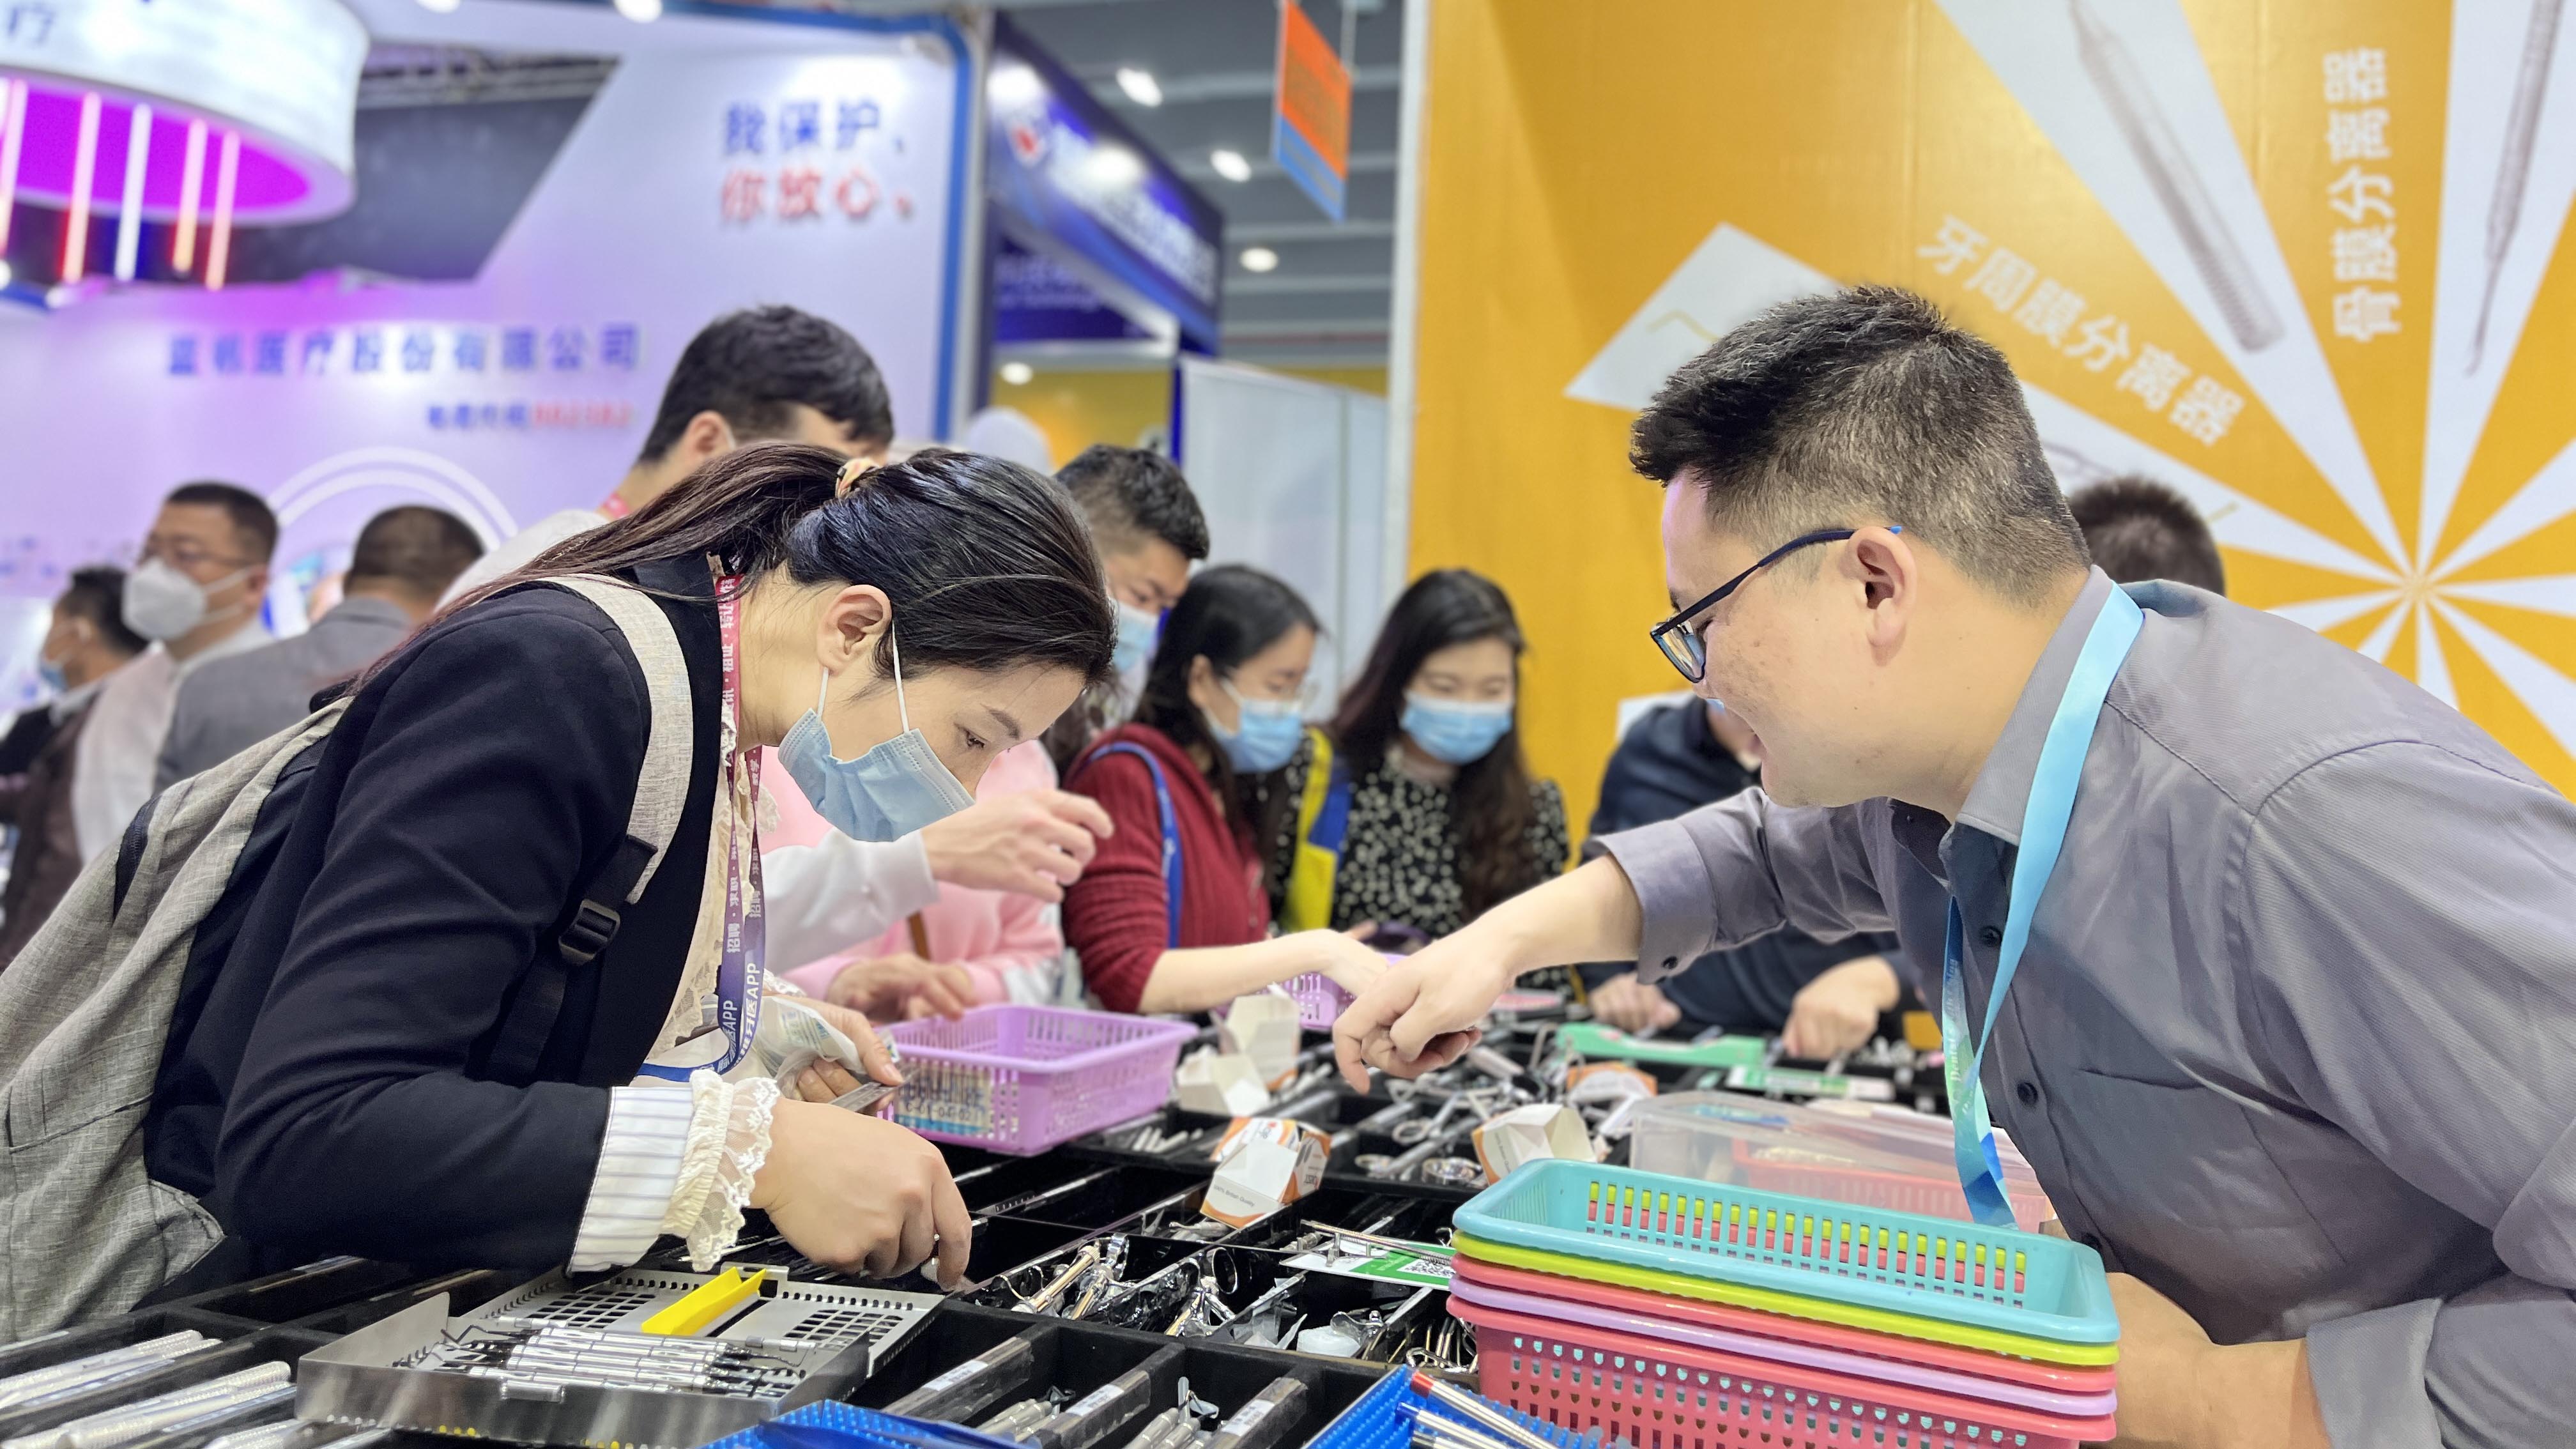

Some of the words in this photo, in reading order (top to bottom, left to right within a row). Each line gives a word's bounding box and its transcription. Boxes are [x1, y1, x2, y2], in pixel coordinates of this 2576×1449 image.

[2322, 47, 2401, 342] 骨膜分离器
[1915, 214, 2246, 446] 牙周膜分离器
